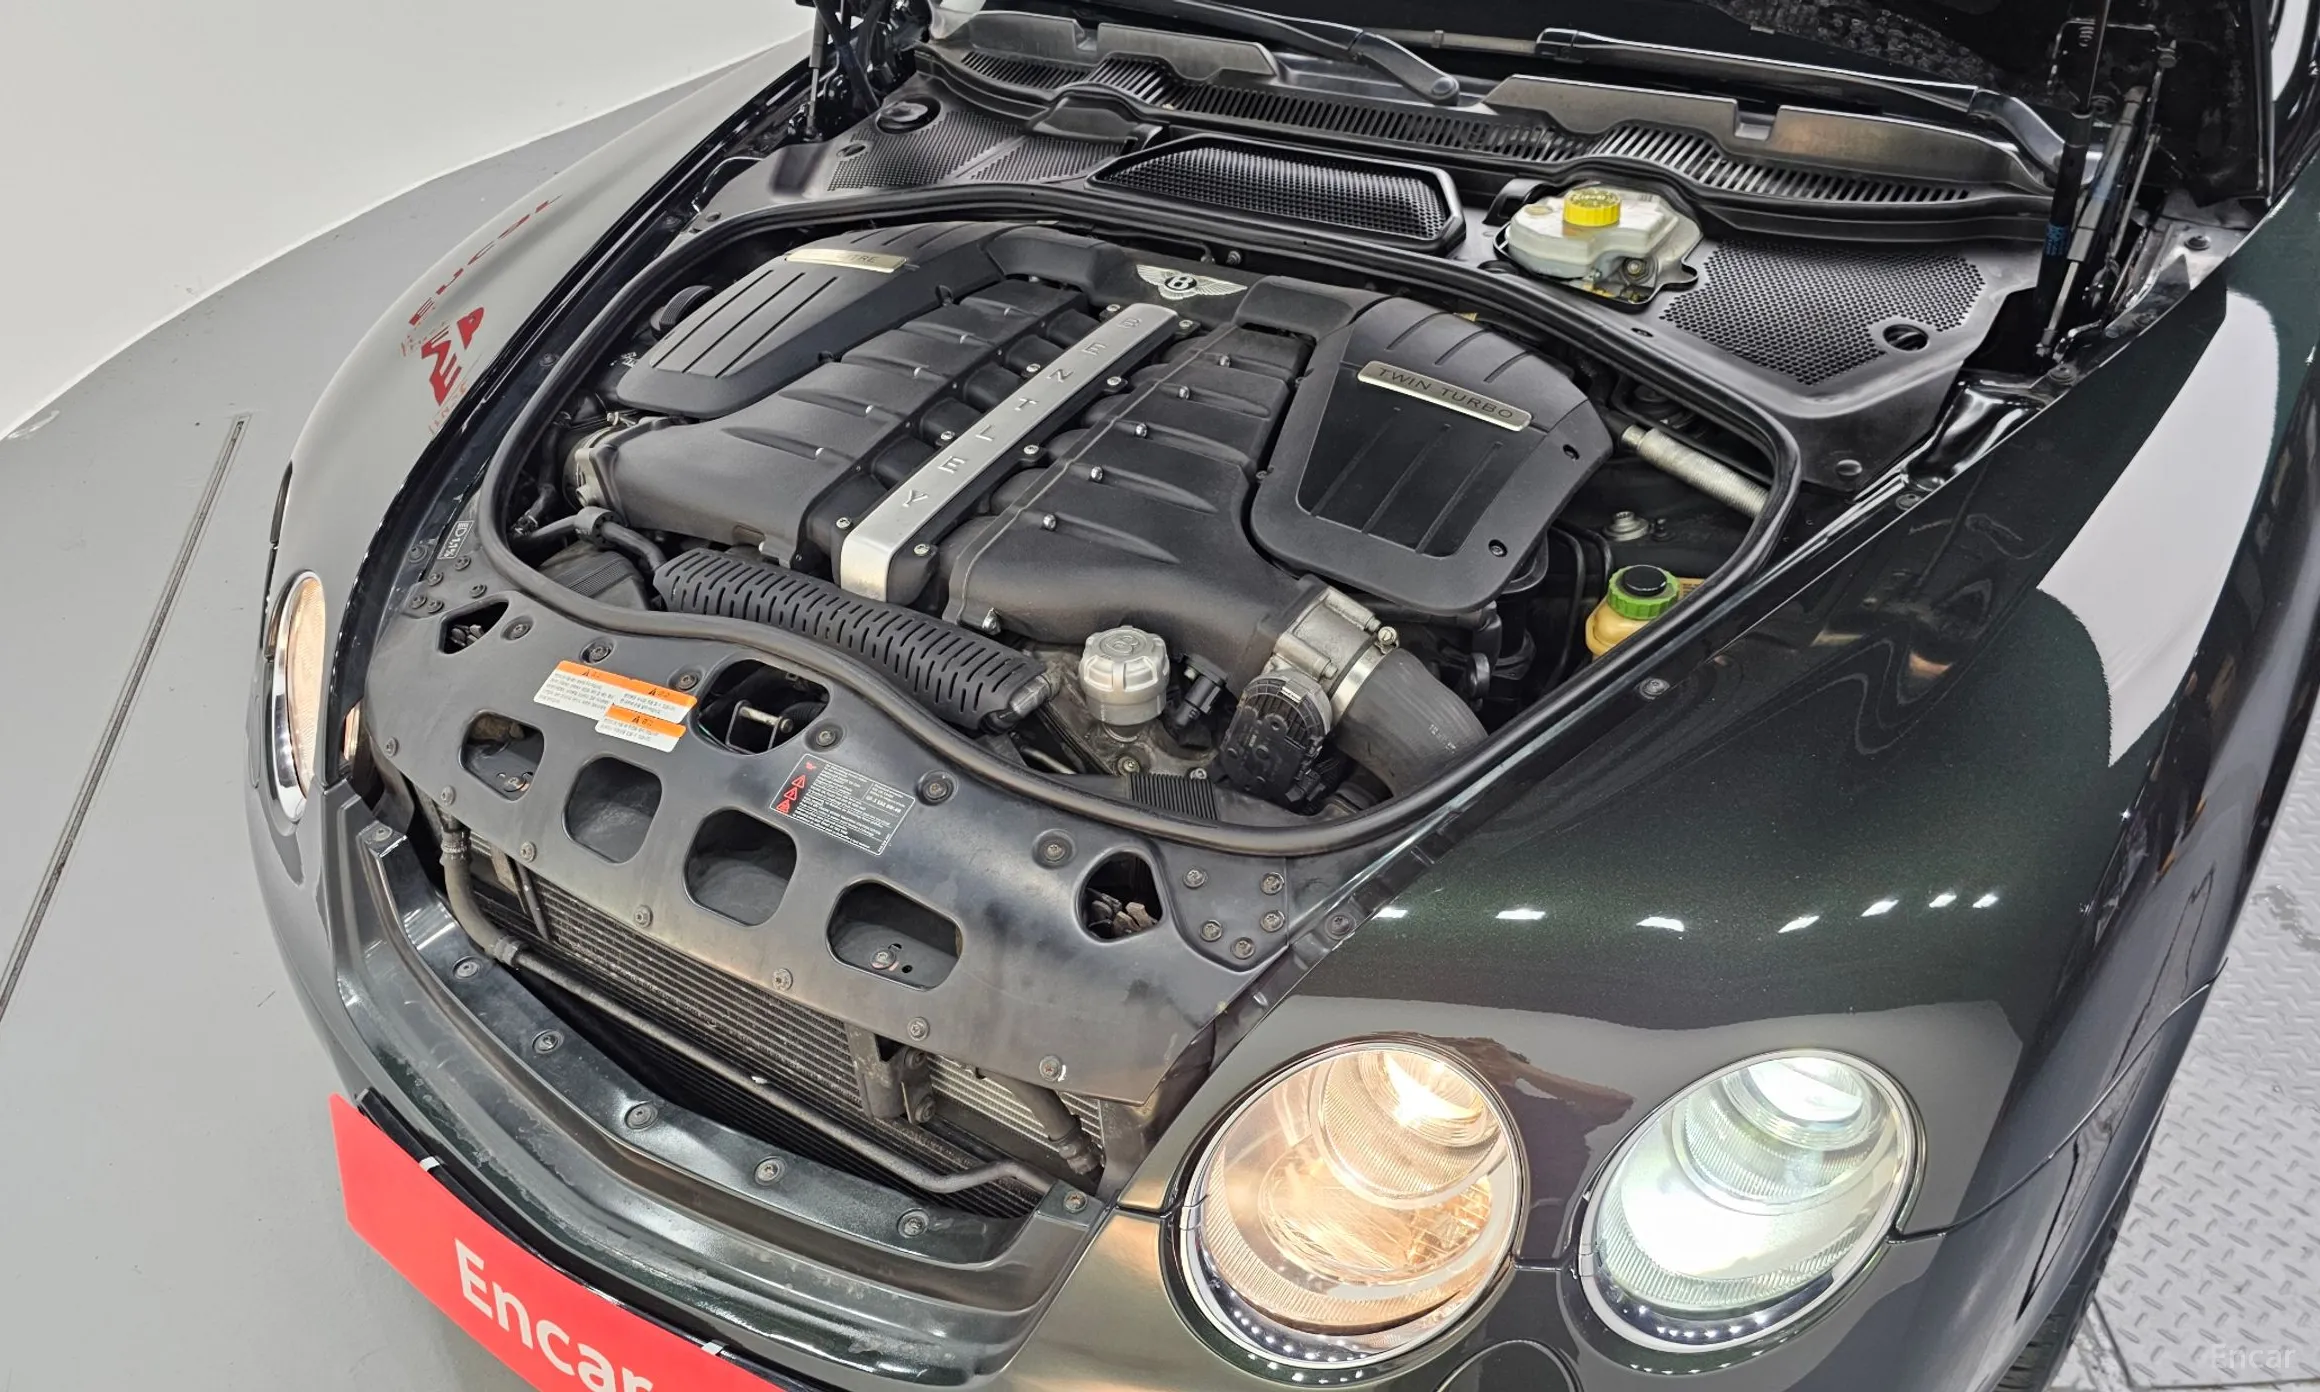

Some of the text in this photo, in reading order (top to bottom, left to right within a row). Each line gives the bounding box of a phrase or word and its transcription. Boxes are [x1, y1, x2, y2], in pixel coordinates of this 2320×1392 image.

[1378, 366, 1514, 420] TWIN TURBO
[454, 1237, 655, 1392] Encar
